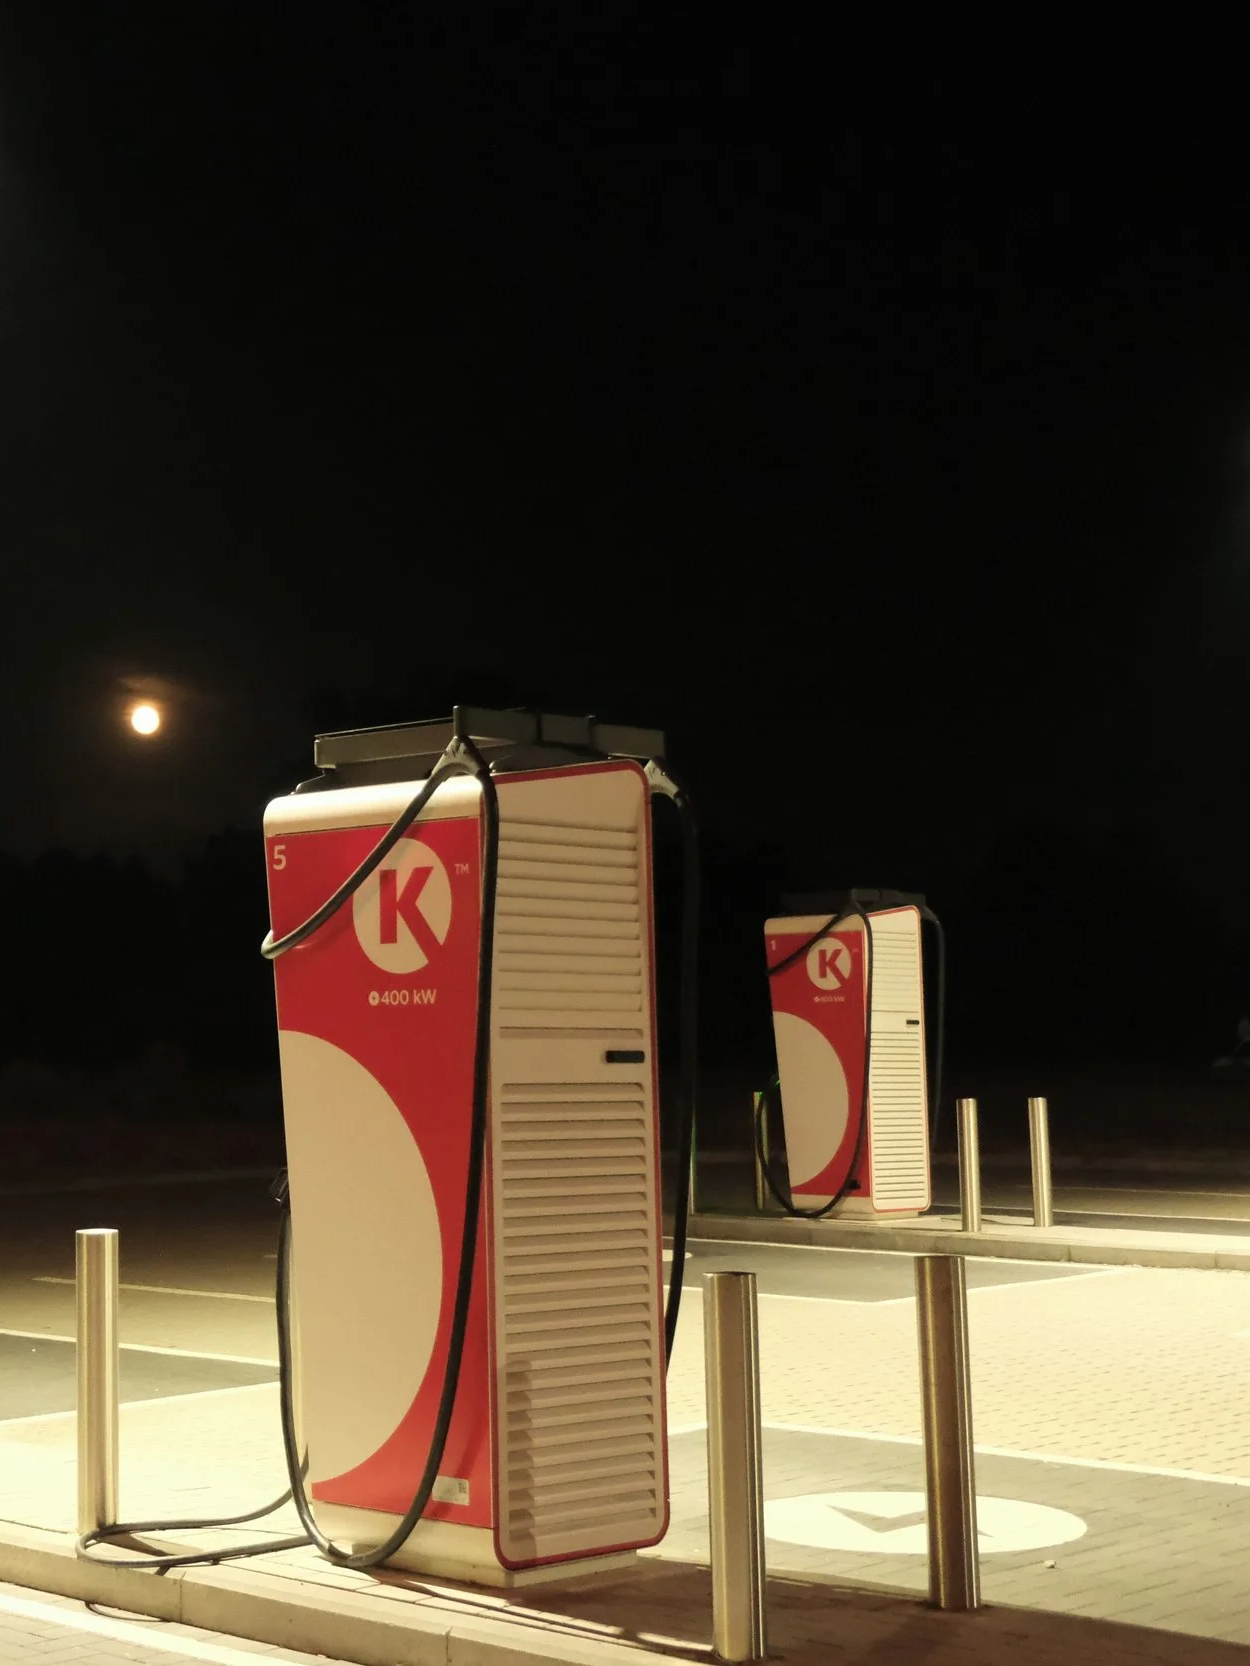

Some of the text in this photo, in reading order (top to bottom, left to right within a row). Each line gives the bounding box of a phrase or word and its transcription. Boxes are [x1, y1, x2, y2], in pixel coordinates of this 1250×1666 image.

[272, 844, 287, 870] 5
[380, 988, 438, 1006] 400 kW
